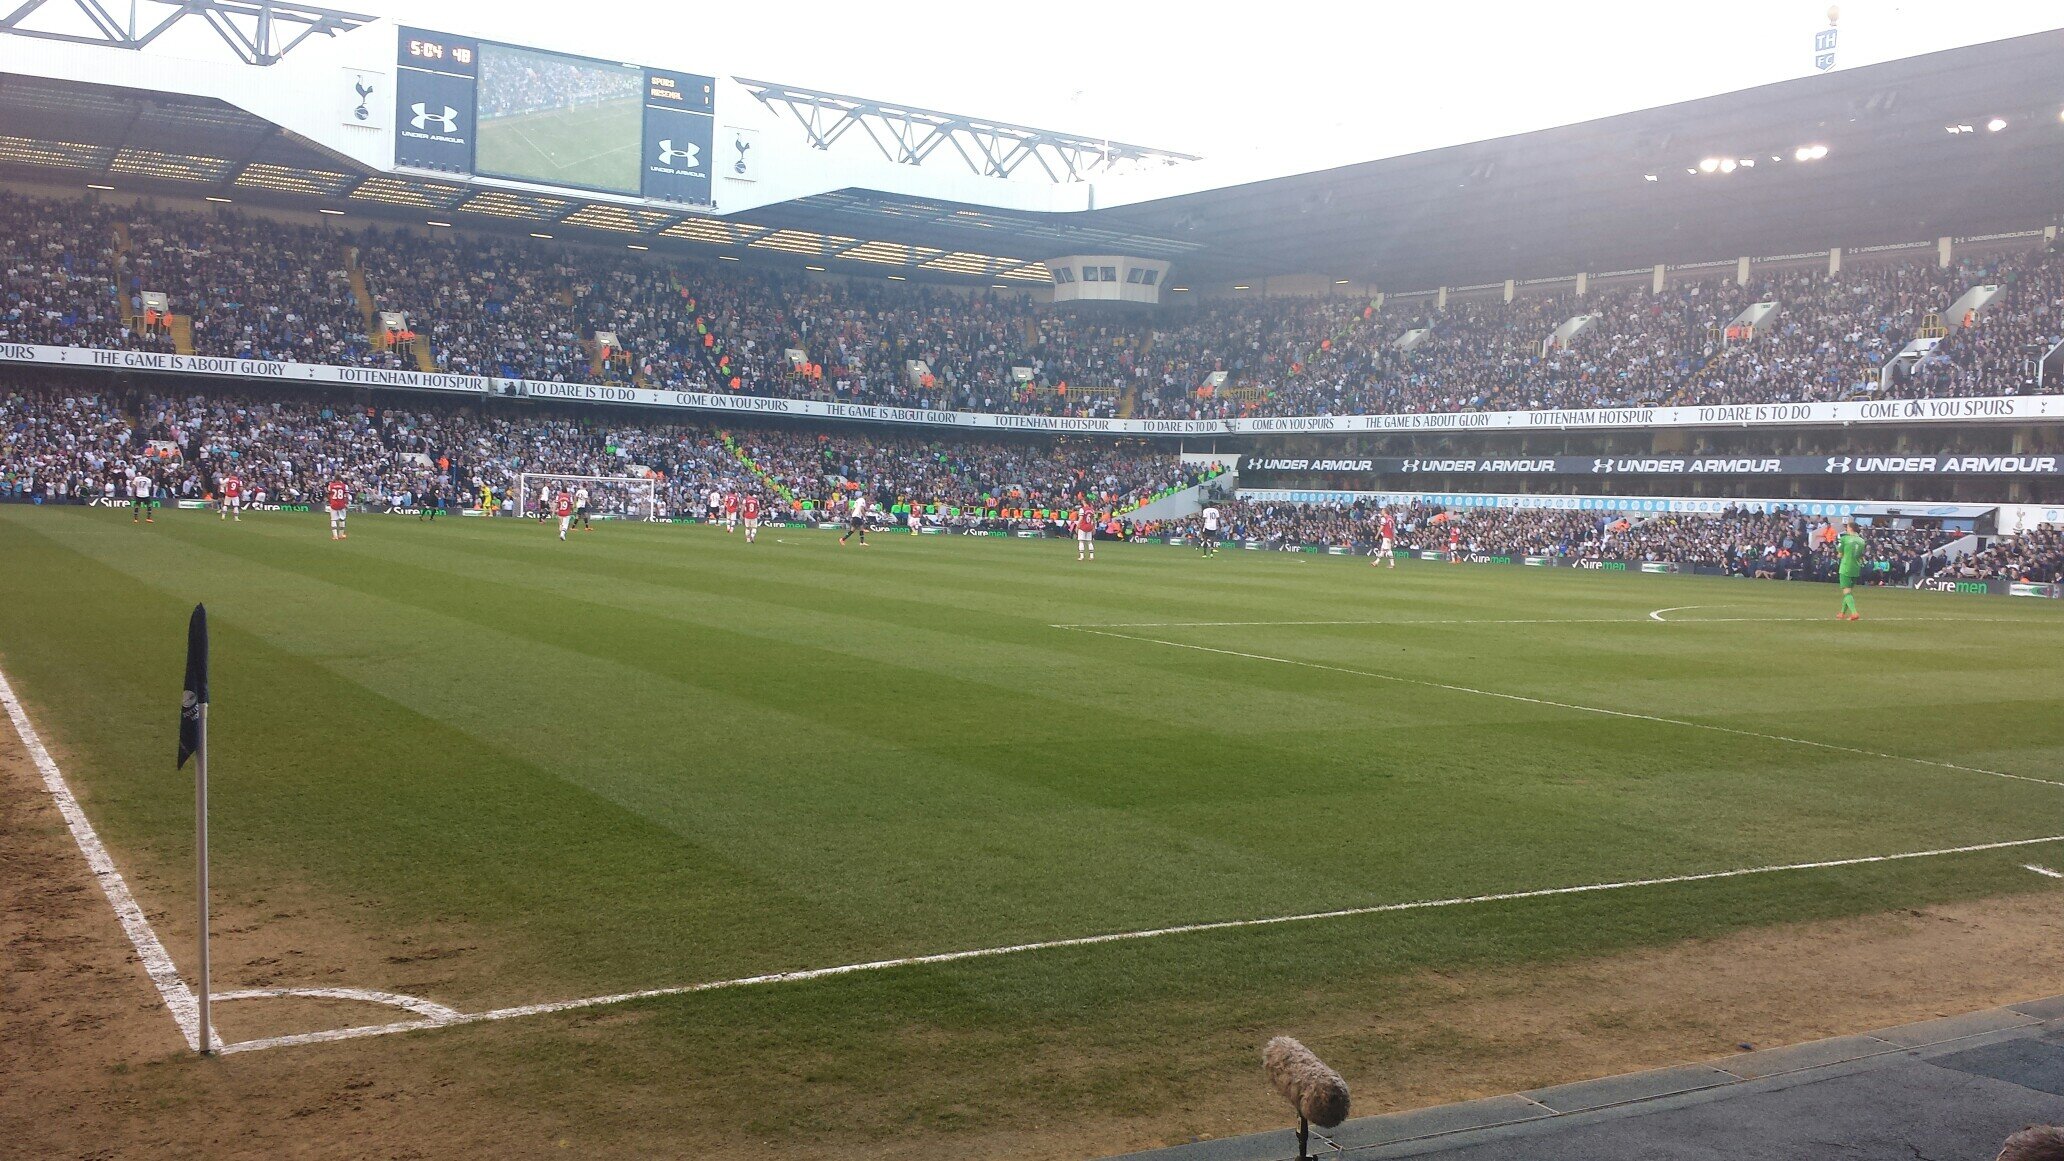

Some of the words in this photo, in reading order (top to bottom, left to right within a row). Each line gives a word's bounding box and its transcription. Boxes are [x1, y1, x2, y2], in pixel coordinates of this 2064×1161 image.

[1816, 32, 1837, 49] TH
[410, 40, 443, 59] 5:04
[1817, 54, 1834, 66] FC
[401, 130, 429, 139] UNDER
[430, 135, 465, 144] ARMOUR
[650, 165, 675, 174] UNDER
[675, 169, 706, 178] ARMOUR
[92, 351, 121, 365] THE
[124, 353, 166, 368] GAME
[171, 356, 183, 370] IS
[187, 358, 237, 373] ABOUT
[241, 361, 285, 376] GLORY
[338, 368, 418, 386] TOTTENHAM
[423, 374, 483, 390] HOTSPUR
[530, 382, 546, 394] TO
[550, 383, 581, 397] DARE
[586, 386, 596, 398] IS
[600, 387, 615, 399] TO
[618, 389, 635, 401] DO
[676, 393, 708, 406] COME
[710, 395, 727, 407] ON
[729, 396, 751, 409] YOU
[754, 399, 788, 411] SPURS
[1860, 403, 1899, 418] COME
[1904, 401, 1926, 417] ON
[1930, 401, 1960, 417] YOU
[1963, 399, 2014, 416] SPURS
[826, 403, 846, 415] THE
[848, 405, 877, 418] GAME
[880, 408, 889, 419] IS
[890, 409, 924, 421] ABOUT
[927, 411, 958, 424] GLORY
[1529, 411, 1595, 425] TOTTENHAM
[1599, 410, 1653, 424] HOTSPUR
[1698, 408, 1715, 421] TO
[1717, 407, 1751, 421] DARE
[1755, 406, 1767, 420] IS
[1771, 405, 1788, 420] TO
[1791, 404, 1811, 420] DO
[994, 415, 1057, 429] TOTTENHAM
[1060, 419, 1109, 431] HOTSPUR
[1142, 420, 1154, 431] TO
[1157, 421, 1182, 432] DARE
[1185, 421, 1194, 432] IS
[1195, 421, 1205, 432] TO
[1206, 421, 1218, 432] DO
[1252, 419, 1274, 430] COME
[1275, 419, 1287, 430] ON
[1289, 418, 1306, 430] YOU
[1307, 417, 1334, 430] SPURS
[1366, 416, 1381, 429] THE
[1384, 415, 1410, 428] GAME
[1412, 415, 1421, 428] IS
[1422, 414, 1457, 427] ABOUT
[1459, 413, 1491, 427] GLORY
[1264, 459, 1308, 471] UNDER
[1310, 460, 1373, 471] ARMOUR
[1421, 460, 1477, 472] UNDER
[1479, 460, 1555, 472] ARMOUR
[1616, 459, 1685, 473] UNDER
[1688, 459, 1781, 474] ARMOUR
[1855, 457, 1937, 472] UNDER
[1941, 457, 2056, 473] ARMOUR
[331, 489, 344, 500] 28
